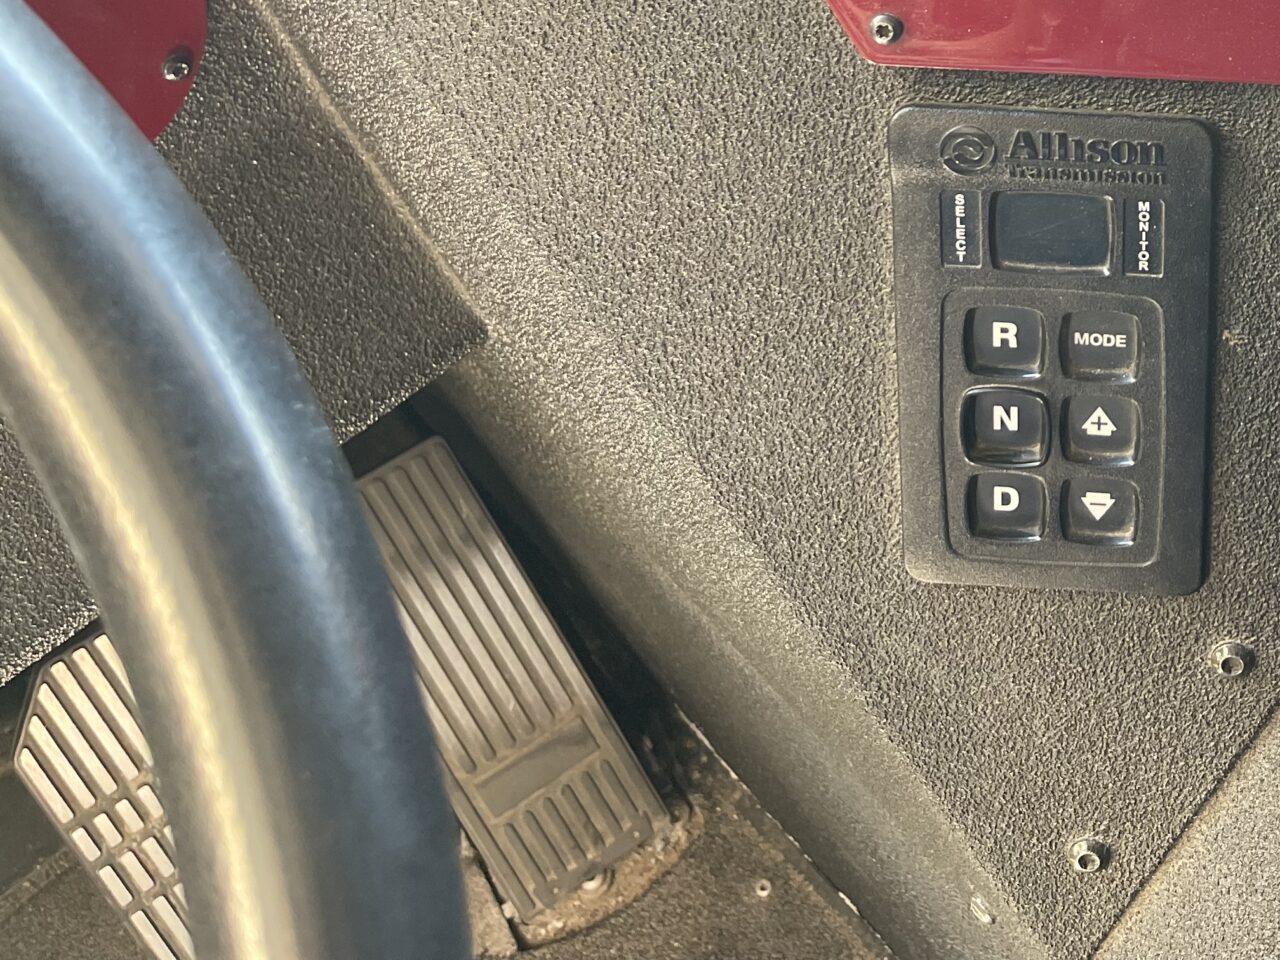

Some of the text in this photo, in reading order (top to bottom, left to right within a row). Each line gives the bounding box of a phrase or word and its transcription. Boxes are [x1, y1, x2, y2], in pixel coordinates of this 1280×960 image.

[1003, 129, 1167, 166] Allison
[954, 193, 968, 263] SELECT
[1138, 200, 1151, 271] MONITOR
[992, 321, 1018, 348] R
[1074, 332, 1127, 348] MODE
[992, 405, 1019, 431] N
[993, 486, 1020, 512] D
